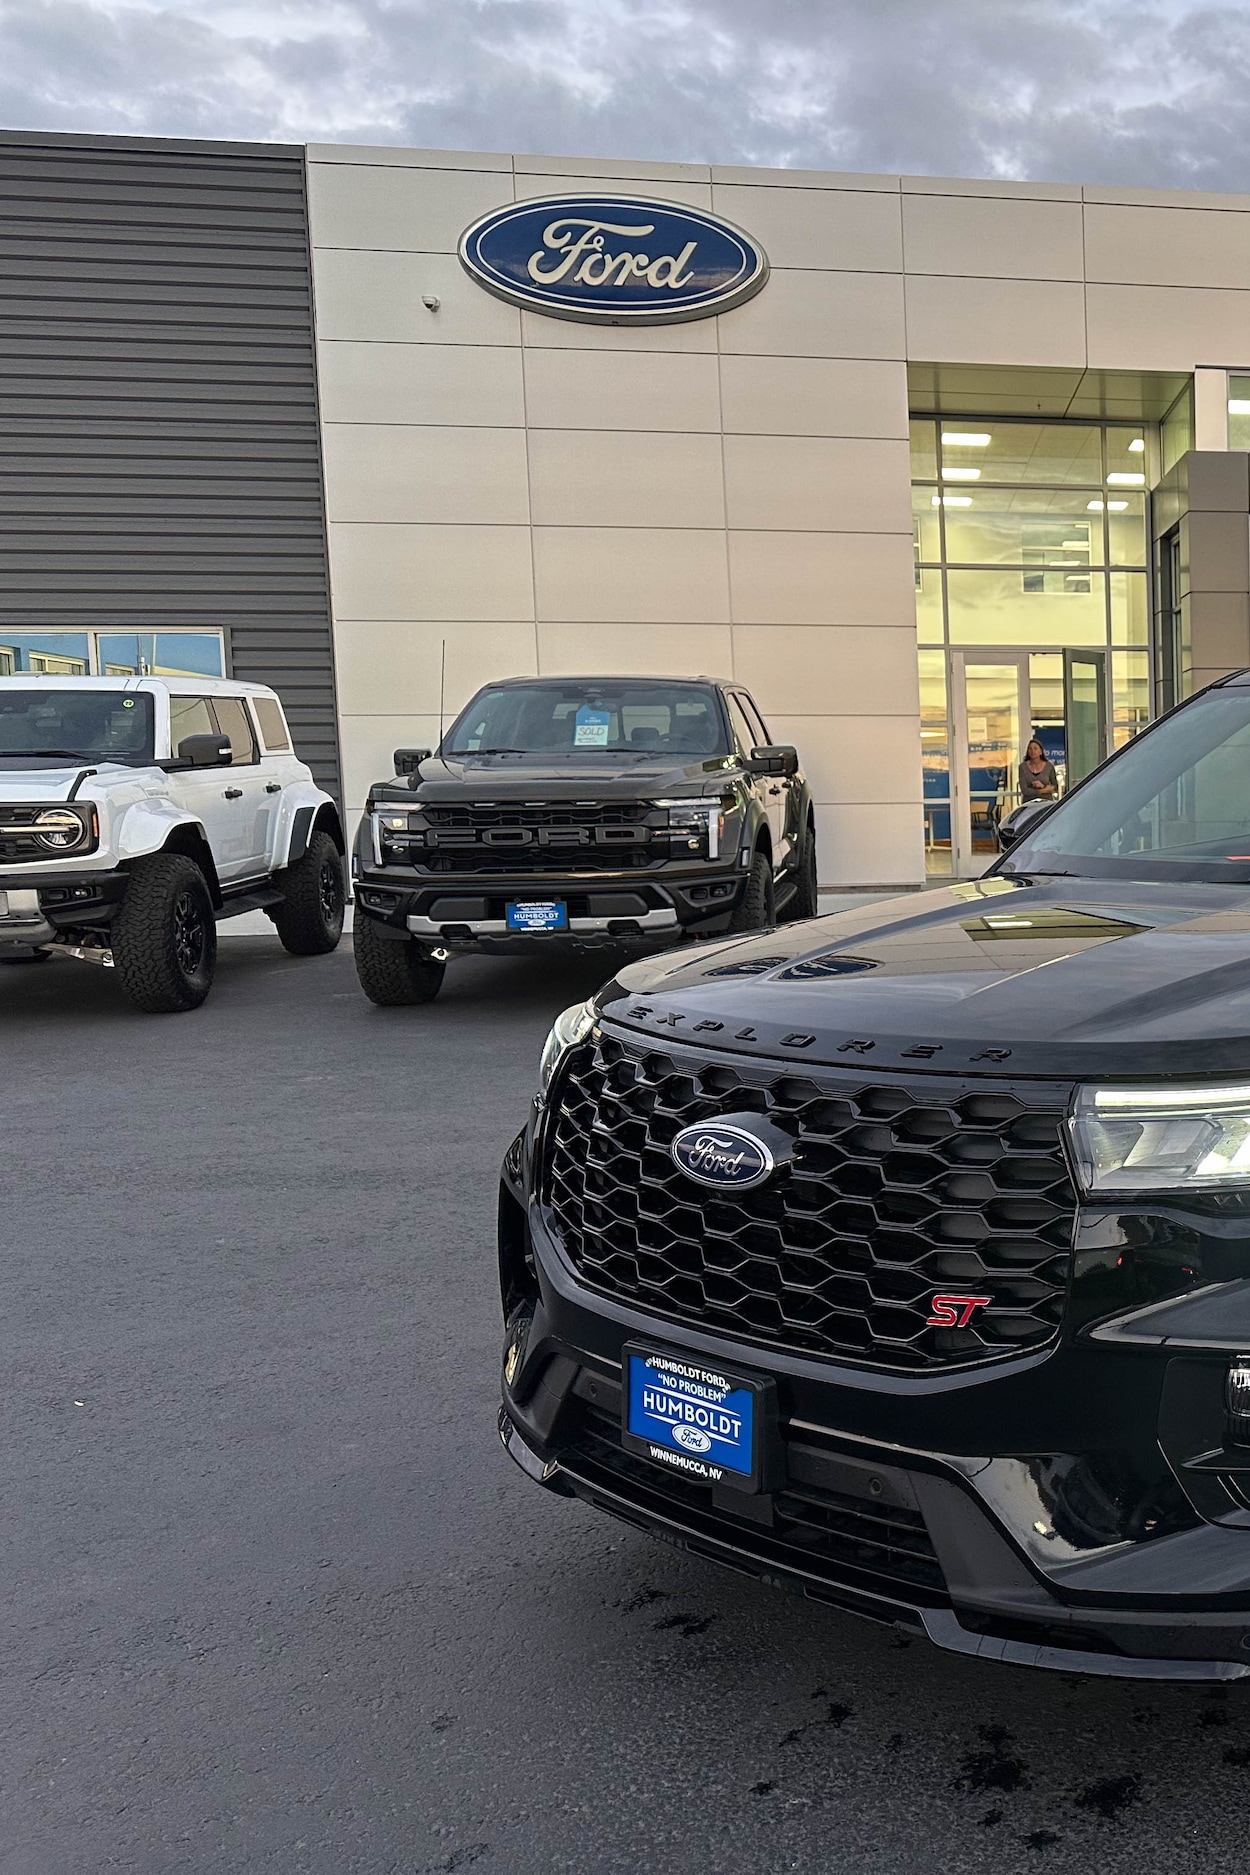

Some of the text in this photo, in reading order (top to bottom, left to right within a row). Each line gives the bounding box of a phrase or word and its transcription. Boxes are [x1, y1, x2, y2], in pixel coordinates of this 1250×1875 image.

[527, 218, 698, 289] Ford
[577, 726, 606, 737] SOLD
[423, 826, 652, 848] FORD
[513, 912, 560, 920] HUMBOLDT
[625, 1004, 1013, 1063] EXPLORER
[687, 1135, 746, 1177] Ford
[925, 1294, 993, 1328] ST
[651, 1355, 726, 1390] HUMBOLDT FORD
[642, 1390, 742, 1439] HUMBOLDT
[680, 1428, 704, 1449] Ford
[649, 1445, 723, 1481] WINNEMUCCA, NV
